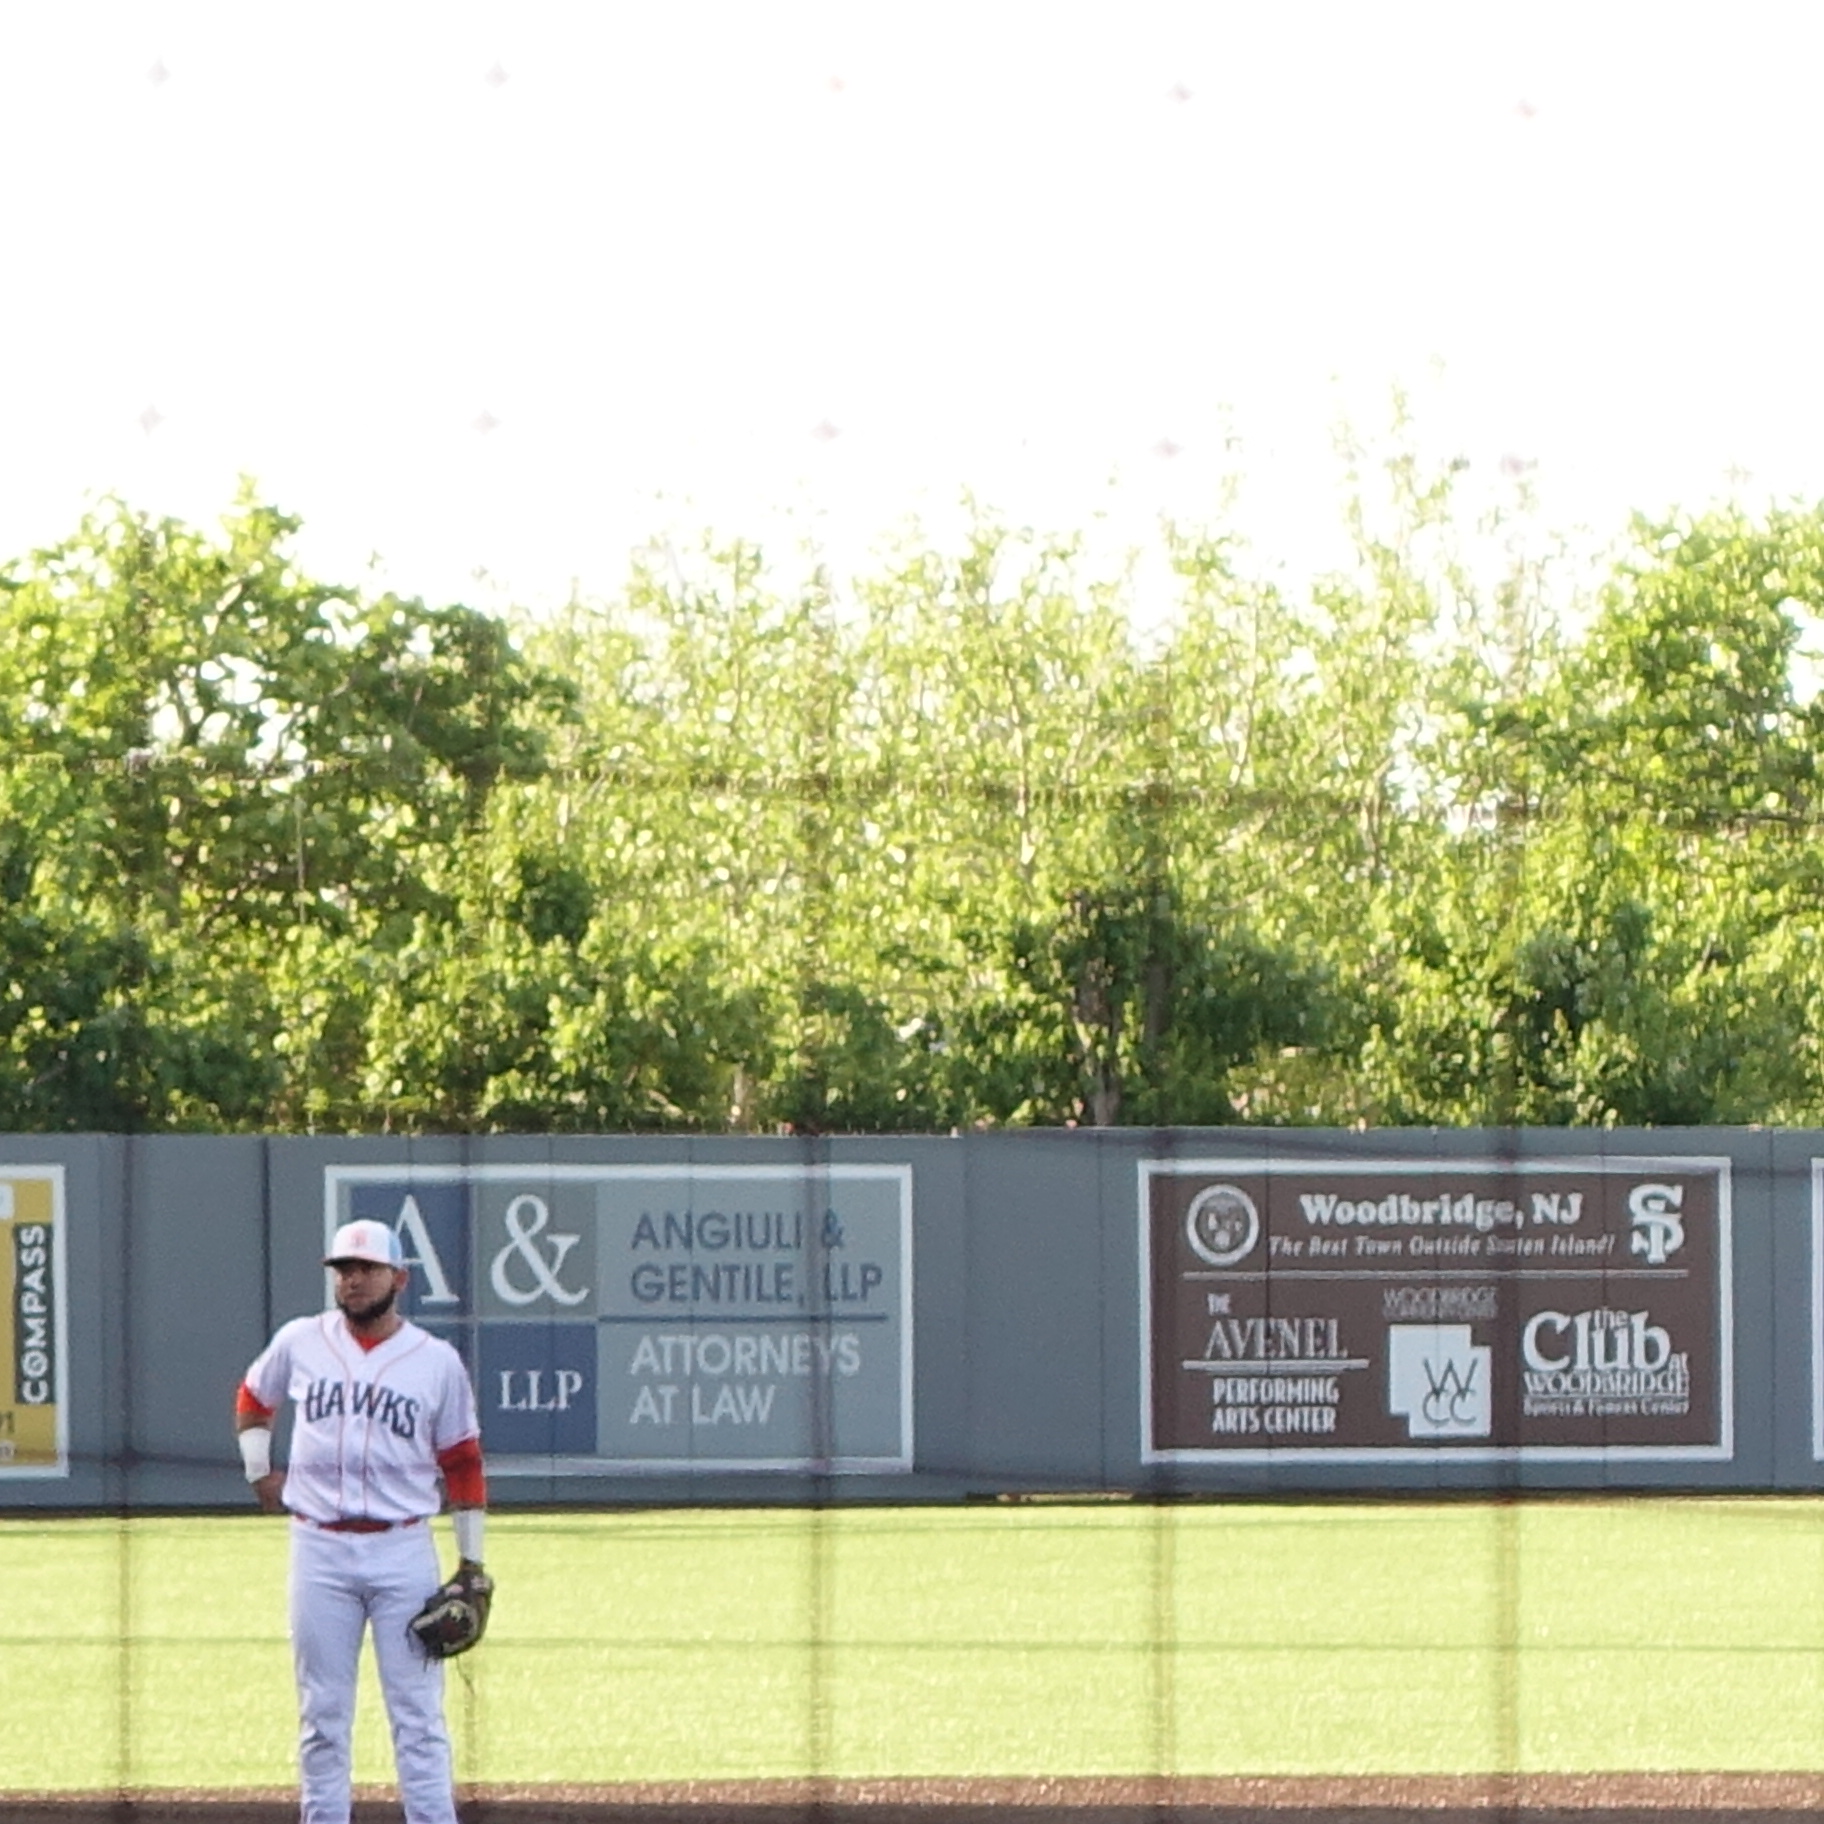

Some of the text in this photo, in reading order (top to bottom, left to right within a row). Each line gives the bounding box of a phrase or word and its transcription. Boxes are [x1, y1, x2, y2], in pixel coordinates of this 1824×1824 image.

[630, 1208, 845, 1251] ANGIULI &
[1299, 1191, 1584, 1232] Woodbridge, NJ
[490, 1194, 592, 1306] &
[1270, 1234, 1303, 1257] The
[630, 1263, 884, 1307] GENTILE, LLP
[21, 1224, 50, 1405] COMPASS
[629, 1334, 862, 1376] ATTORNEYS
[1204, 1317, 1349, 1360] AVENEL
[1523, 1310, 1672, 1373] Club
[303, 1378, 420, 1440] HAWKS
[498, 1370, 583, 1413] LLP
[629, 1385, 776, 1426] AT LAW
[1212, 1377, 1341, 1405] PERFORMING
[1212, 1405, 1337, 1434] ARTS CENTER
